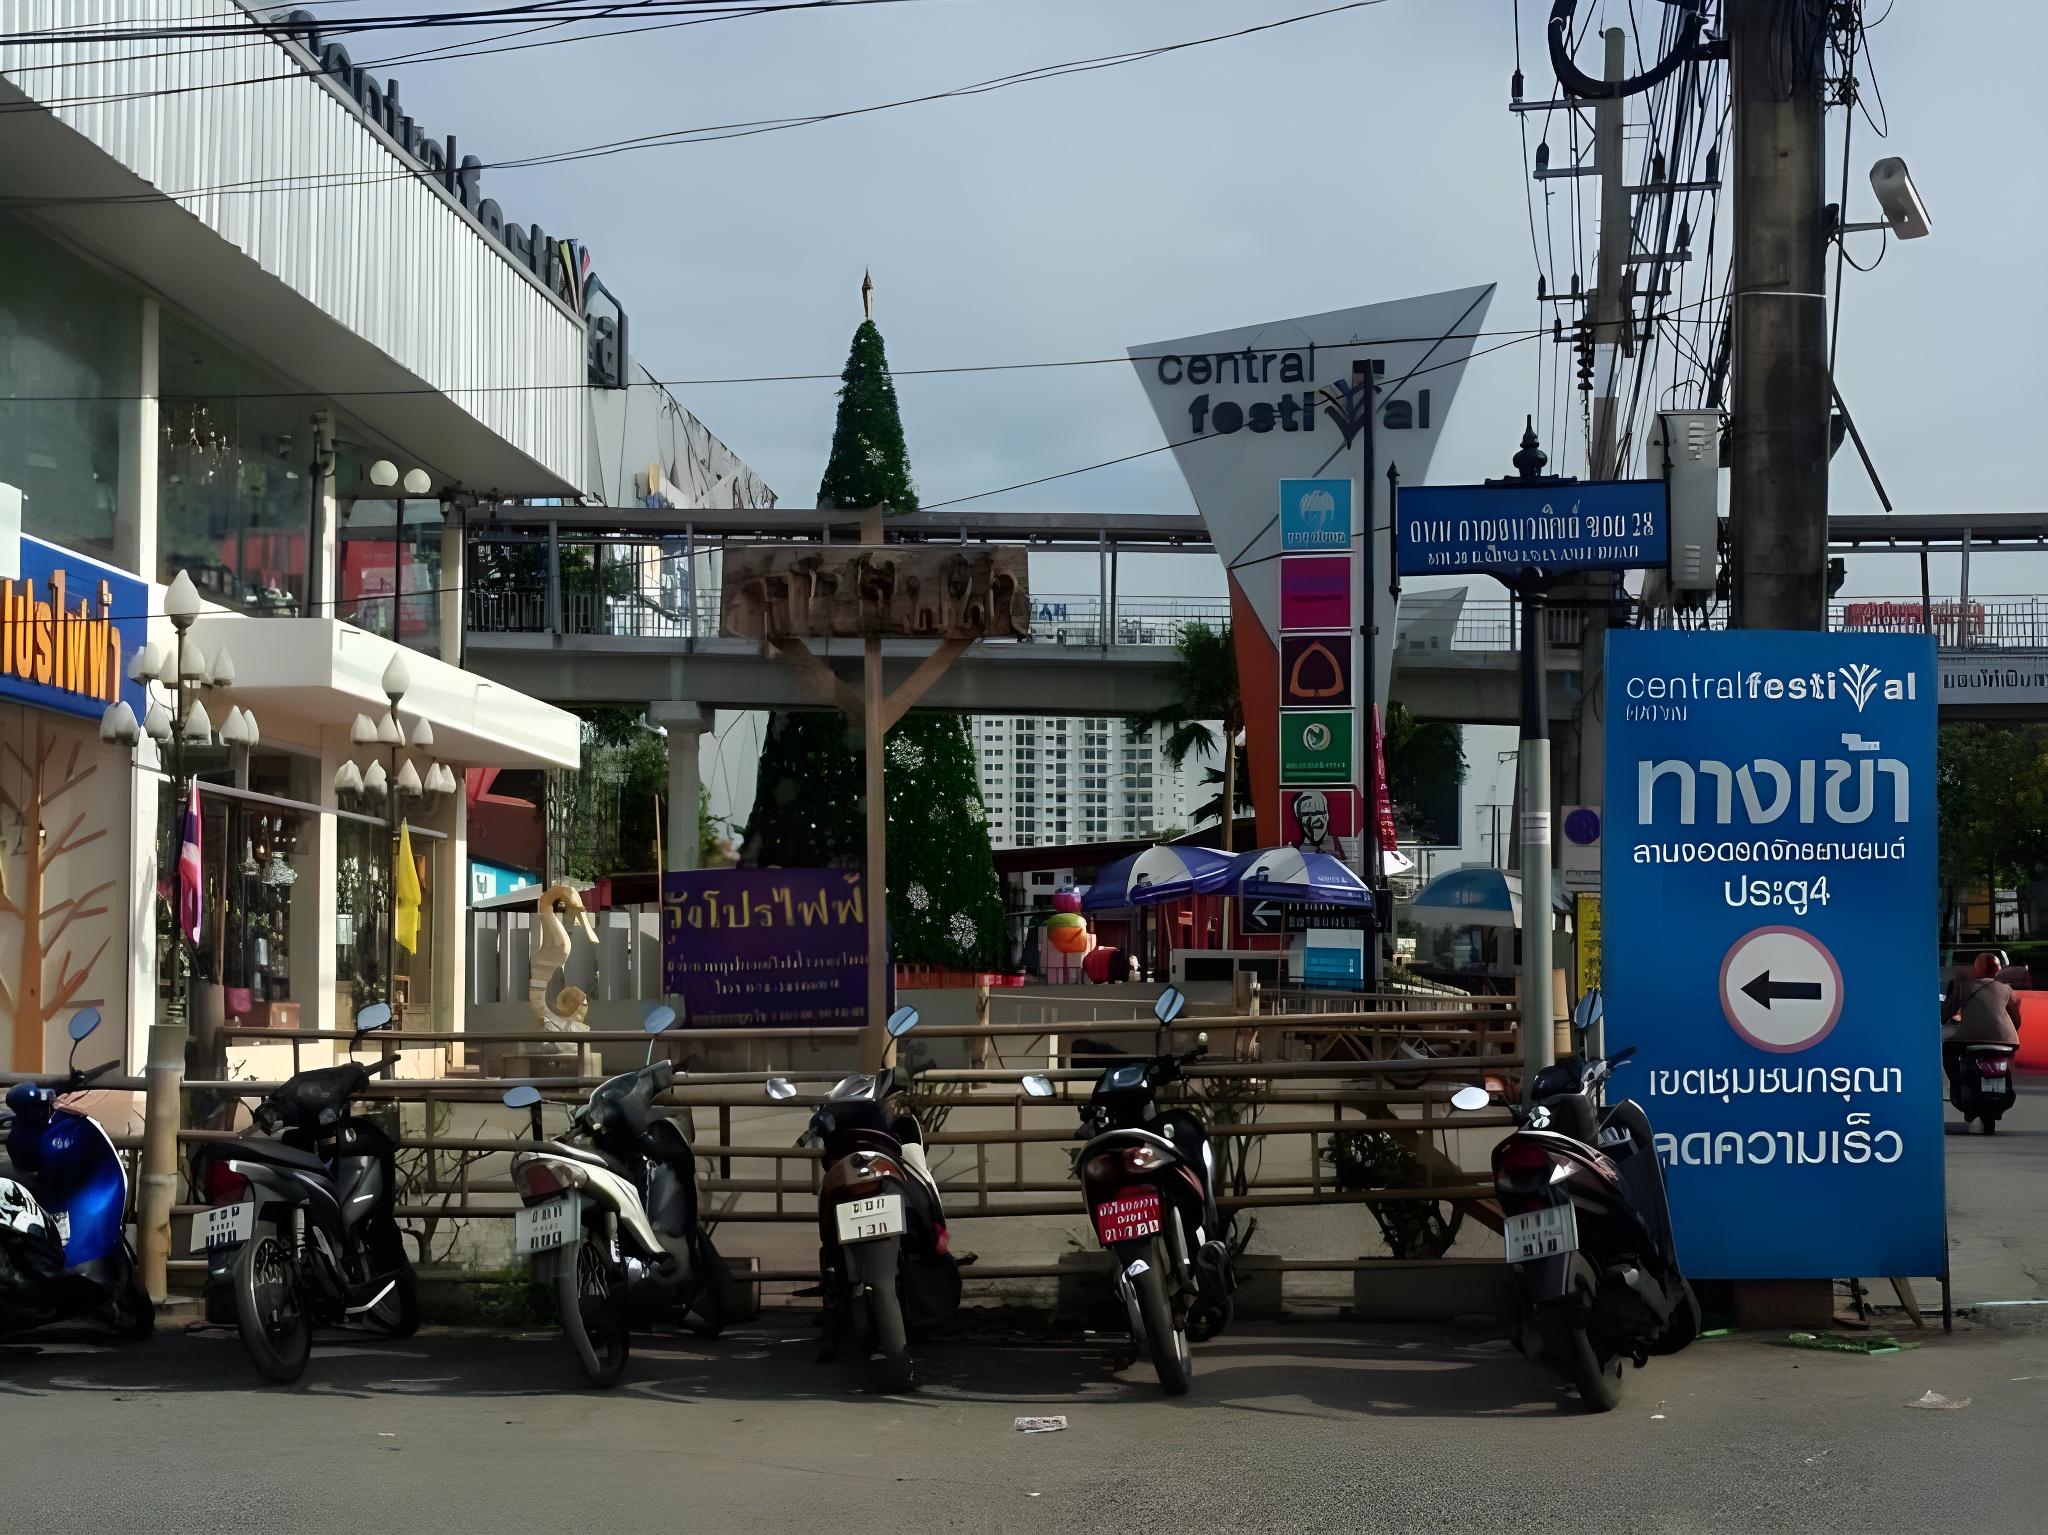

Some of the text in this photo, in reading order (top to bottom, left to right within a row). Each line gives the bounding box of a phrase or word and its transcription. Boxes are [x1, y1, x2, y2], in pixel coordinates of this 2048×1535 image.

[1157, 341, 1316, 386] central
[1631, 511, 1655, 537] 28
[1638, 733, 1911, 826] ทางเข้า
